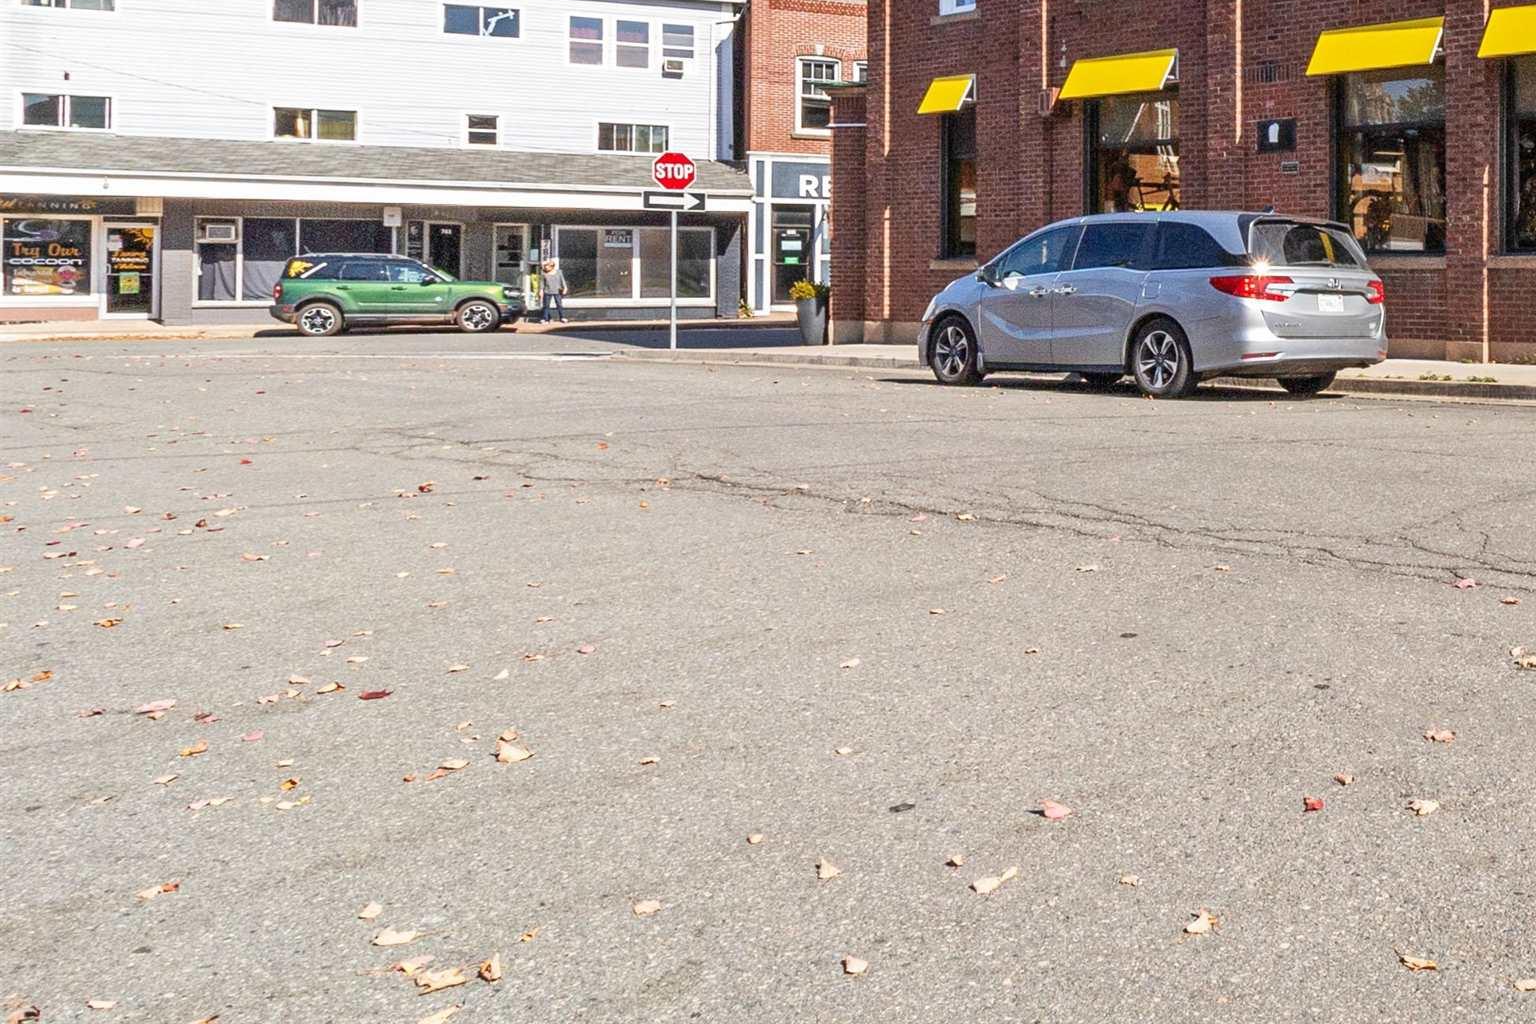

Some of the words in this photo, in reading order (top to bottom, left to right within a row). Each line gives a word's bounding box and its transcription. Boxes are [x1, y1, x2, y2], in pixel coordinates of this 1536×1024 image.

[656, 163, 694, 180] STOP
[605, 235, 632, 243] RENT
[11, 242, 41, 259] Try
[48, 242, 81, 257] Our
